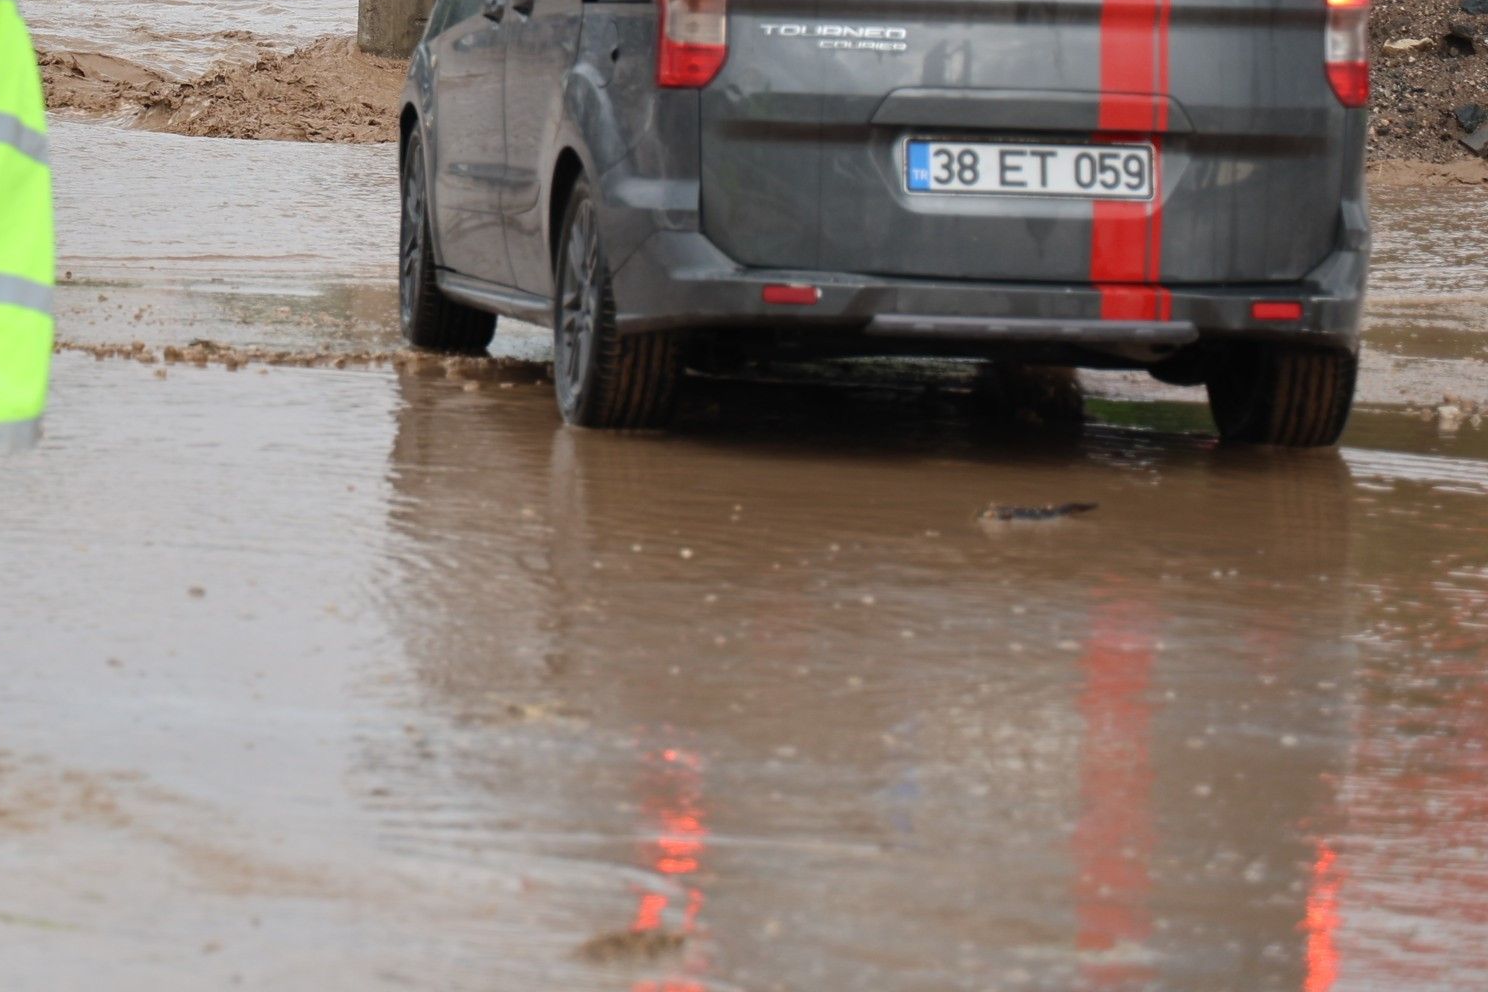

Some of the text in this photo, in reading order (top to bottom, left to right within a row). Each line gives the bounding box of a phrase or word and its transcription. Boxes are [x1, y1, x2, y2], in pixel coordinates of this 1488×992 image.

[760, 24, 907, 39] TOURNEO
[819, 39, 908, 51] COURIER
[912, 169, 928, 180] TR
[933, 147, 1146, 190] 38 ET 059
